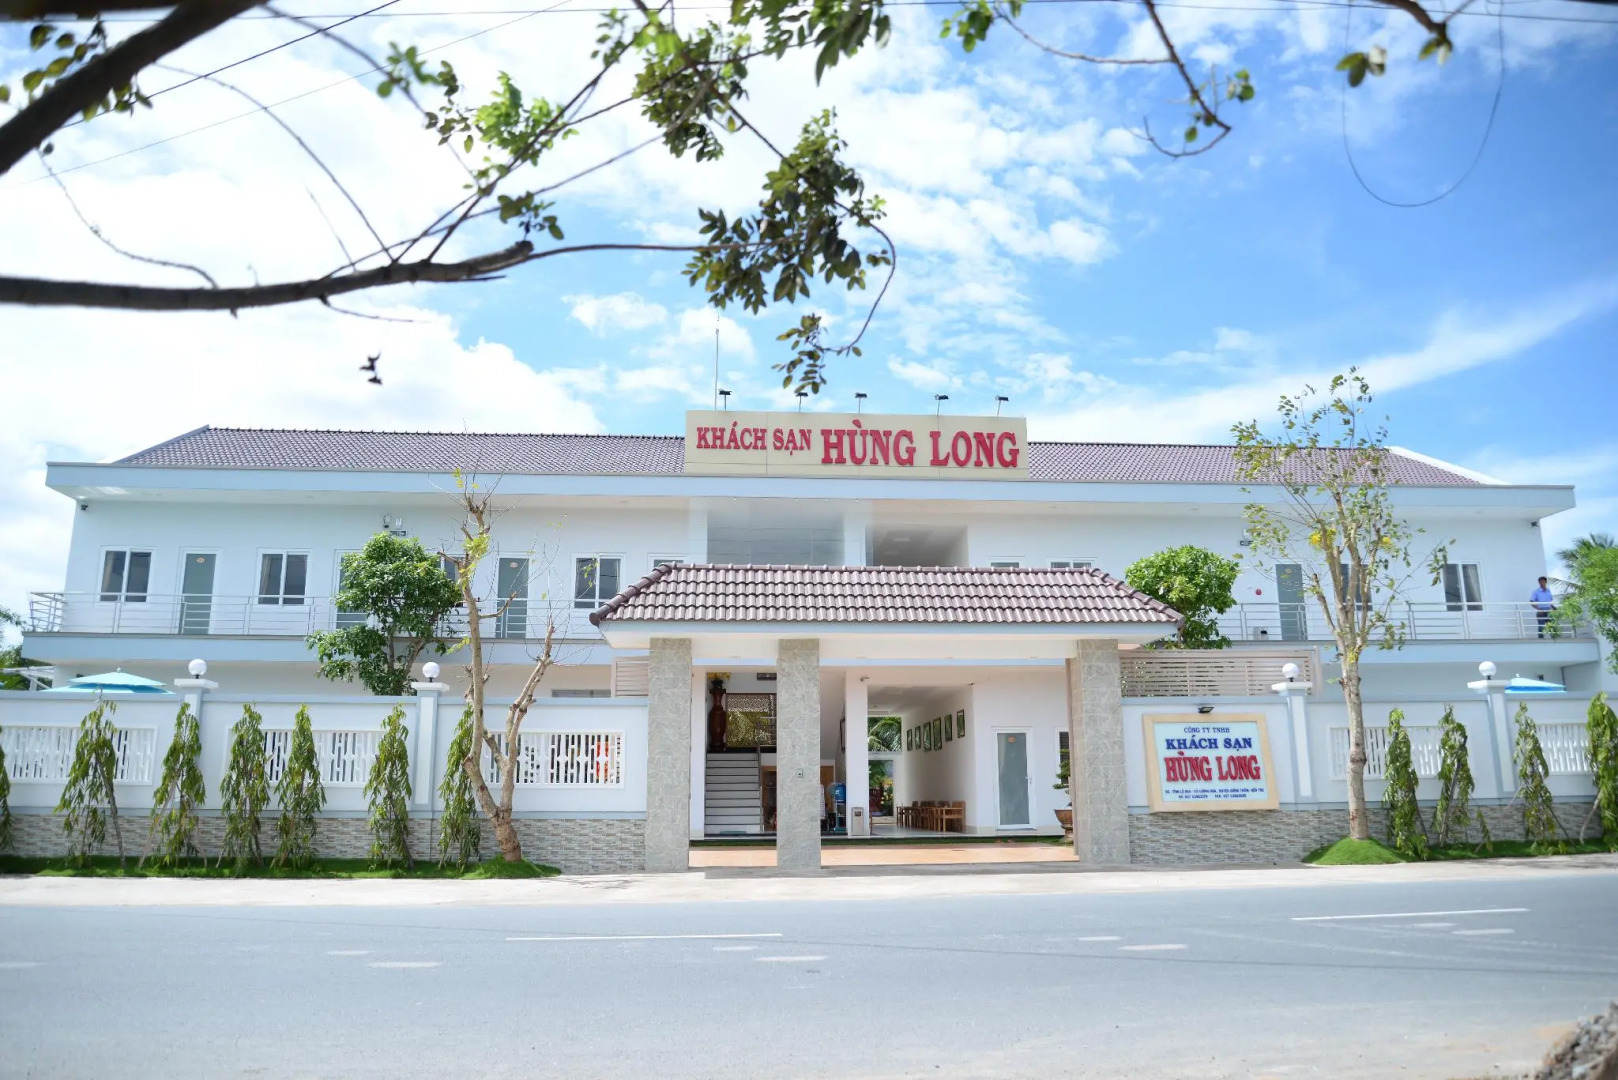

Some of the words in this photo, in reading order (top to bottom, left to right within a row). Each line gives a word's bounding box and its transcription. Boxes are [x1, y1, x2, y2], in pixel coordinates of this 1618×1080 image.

[696, 421, 767, 450] KHÁCH
[773, 428, 812, 456] SẠN
[821, 419, 917, 466] HÙNG
[929, 429, 1020, 468] LONG
[1165, 734, 1219, 750] KHÁCH
[1223, 737, 1252, 752] SẠN
[1163, 750, 1213, 782] HÙNG
[1215, 754, 1261, 781] LONG
